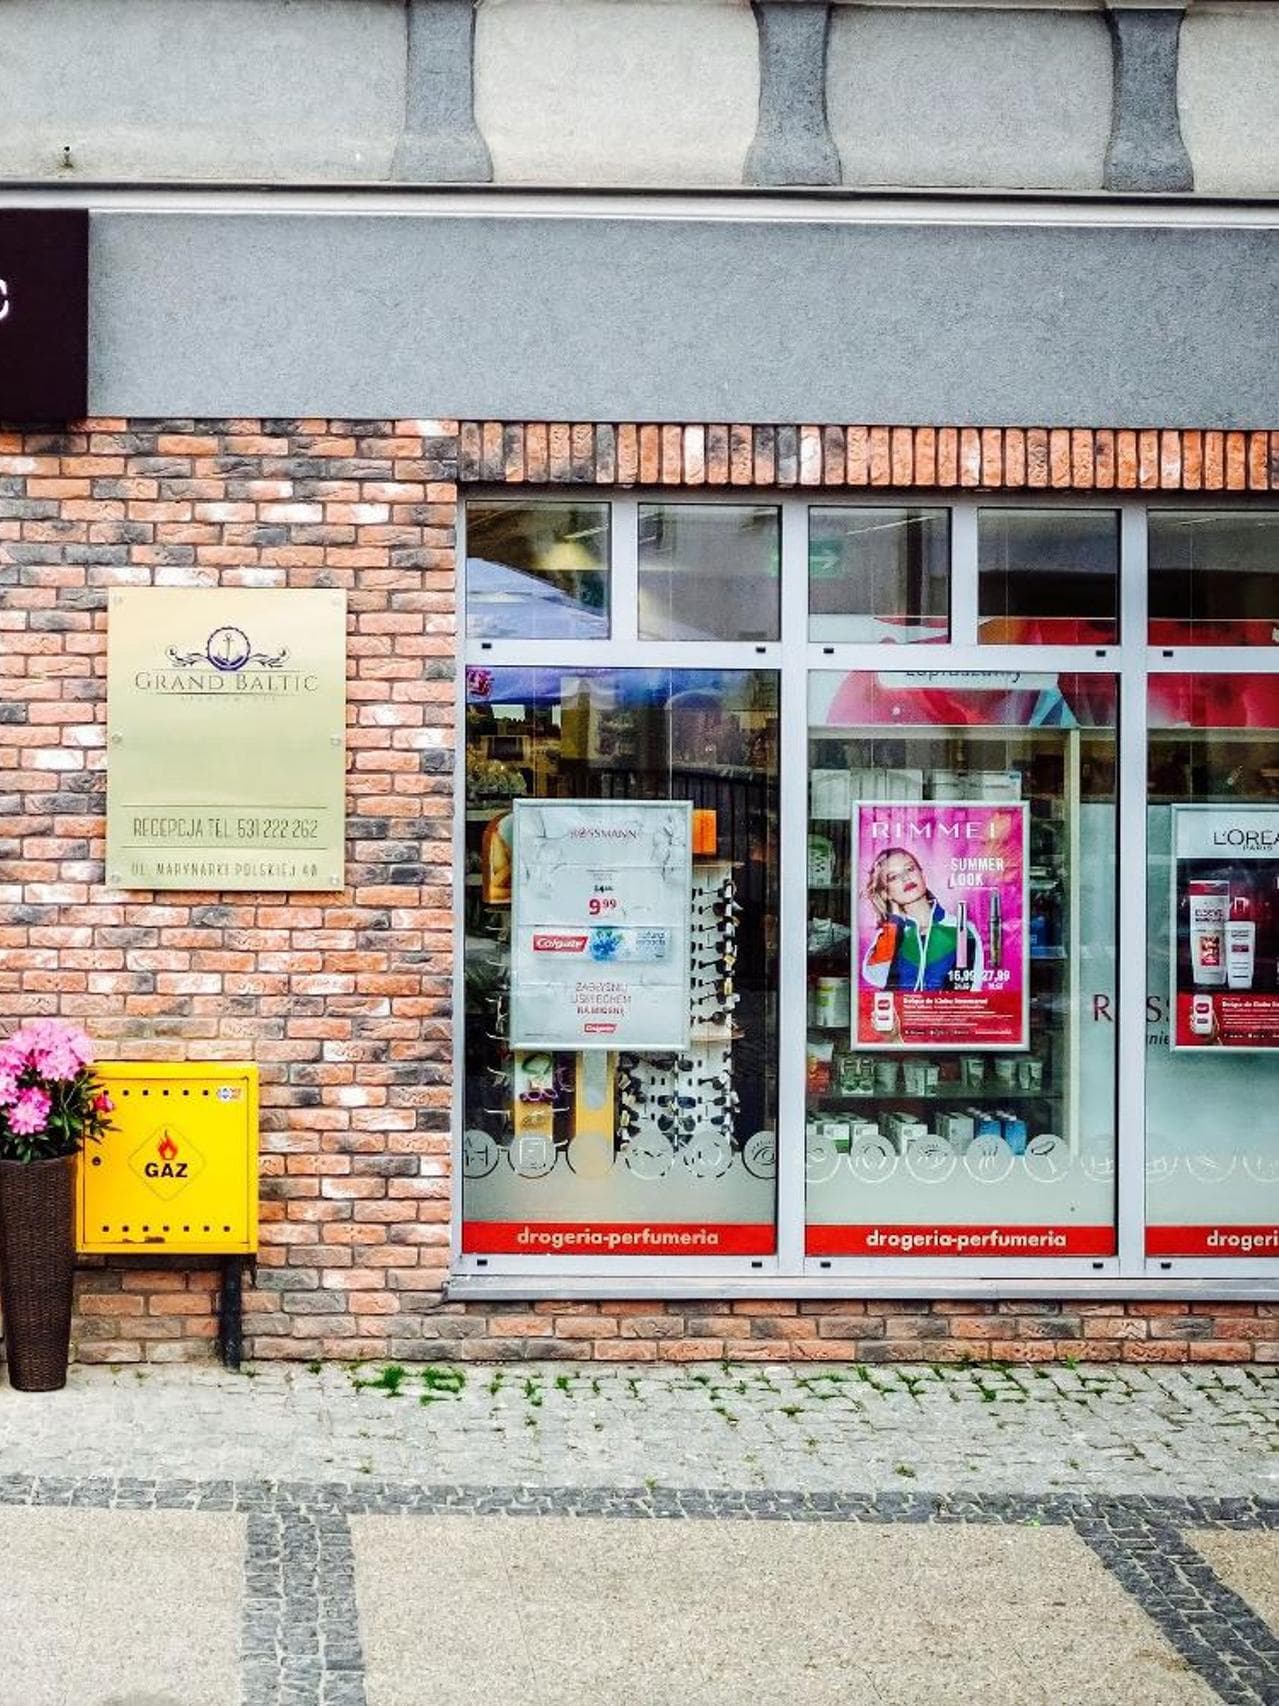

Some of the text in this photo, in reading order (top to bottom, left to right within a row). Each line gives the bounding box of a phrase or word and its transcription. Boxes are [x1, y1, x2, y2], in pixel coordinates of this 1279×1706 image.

[134, 671, 319, 692] GRAND BALTIC
[133, 817, 203, 838] RECEPCJA
[237, 818, 260, 839] 531
[263, 818, 289, 839] 222
[292, 818, 319, 839] 262
[950, 857, 1005, 871] SUMMER
[950, 873, 984, 886] LOOK
[536, 936, 585, 950] Colgate
[145, 1163, 188, 1178] GAZ
[517, 1226, 719, 1249] drogeria-perfumeria
[866, 1229, 1067, 1251] drogeria-perfumeria
[1206, 1229, 1279, 1251] drogeri
